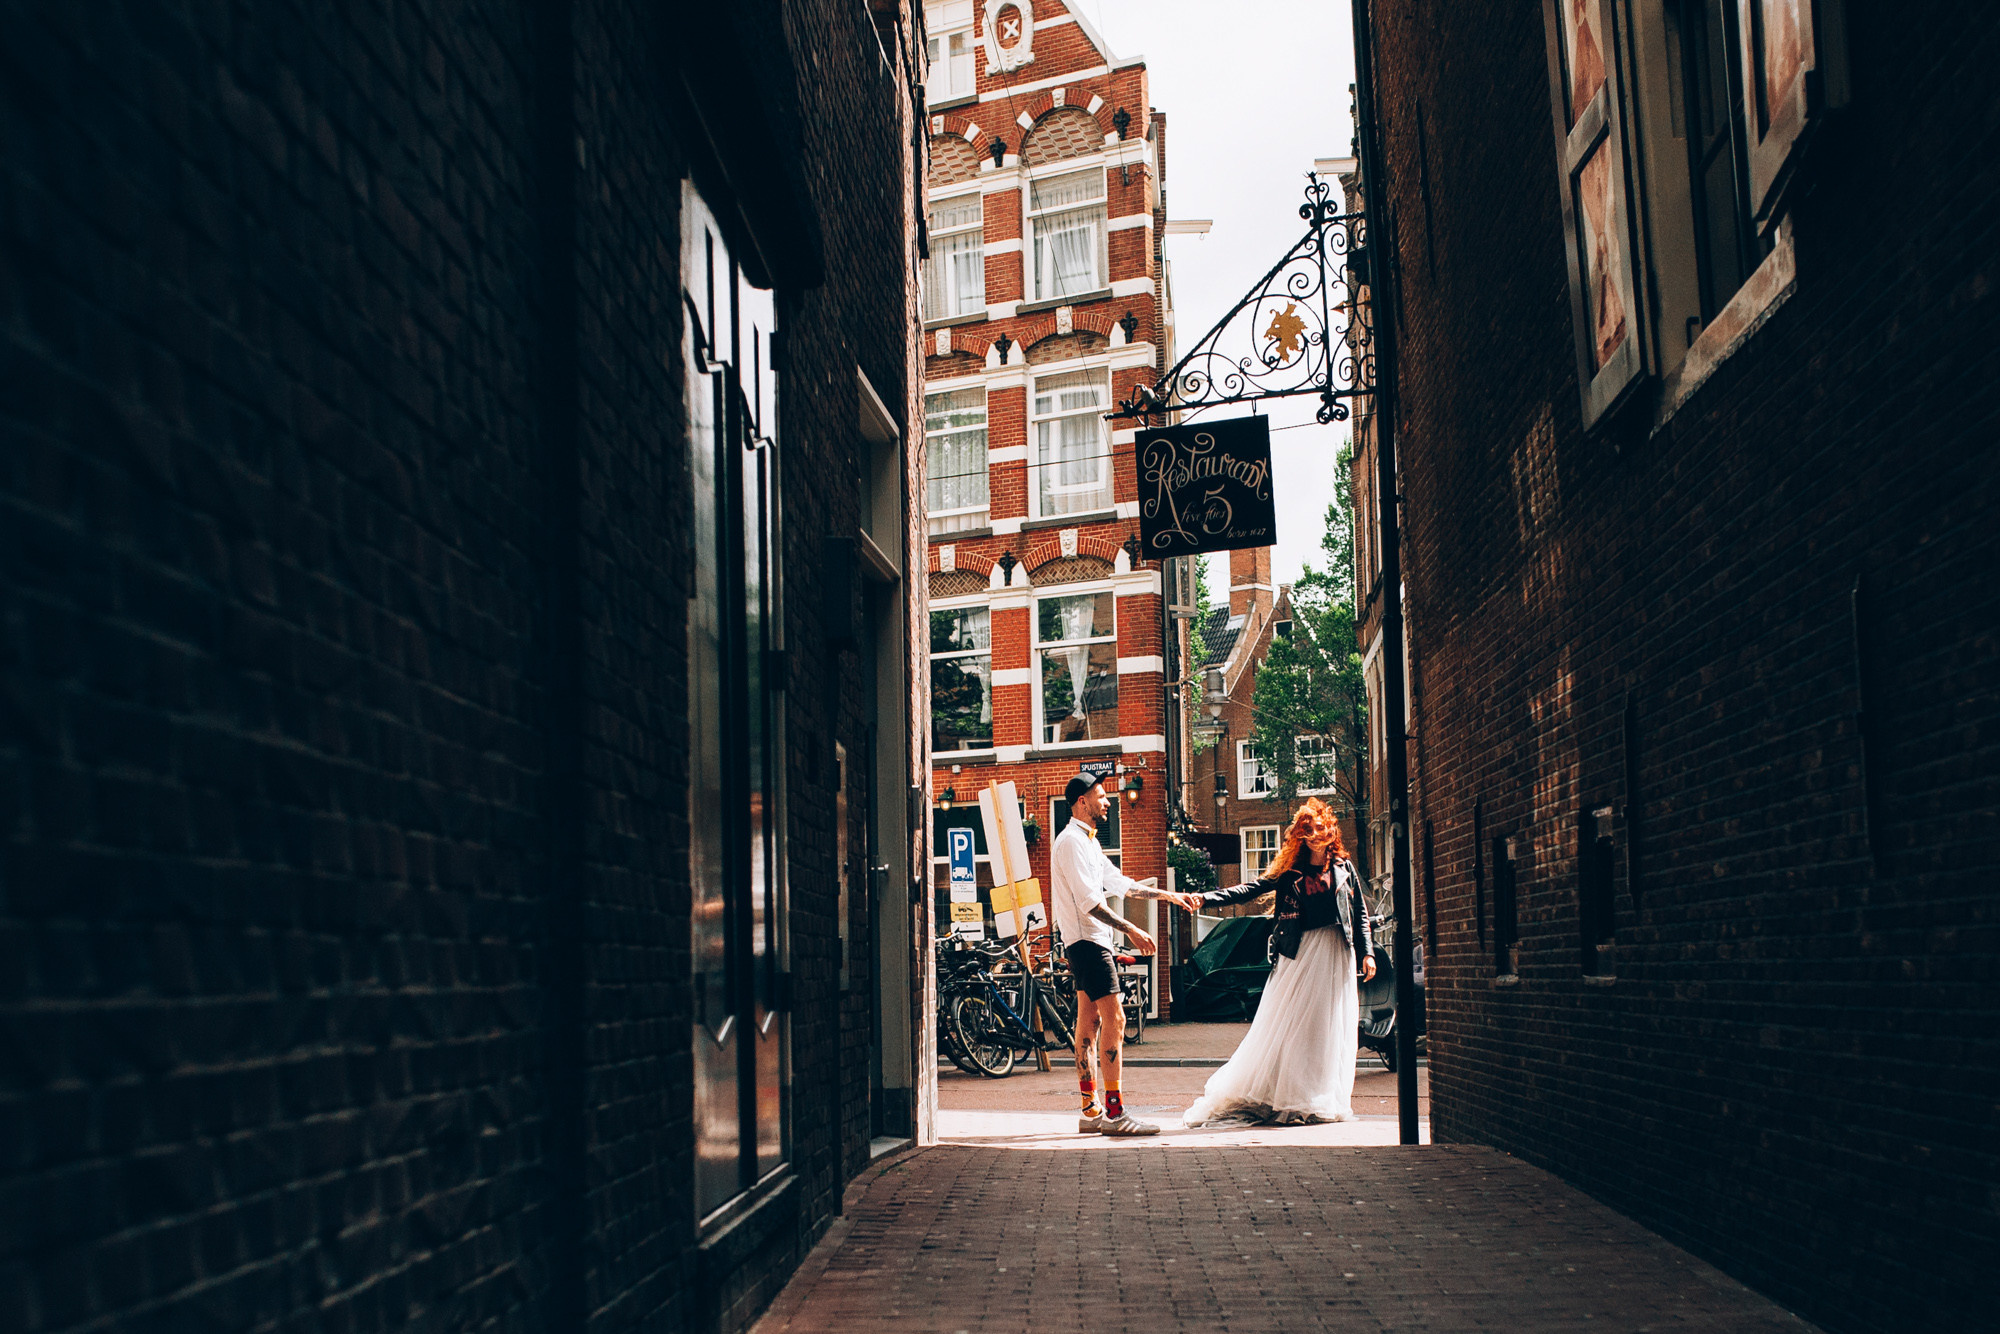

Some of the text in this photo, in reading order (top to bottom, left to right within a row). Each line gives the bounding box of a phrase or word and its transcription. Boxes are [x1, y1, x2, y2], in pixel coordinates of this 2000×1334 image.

[1143, 432, 1269, 549] Restaurant
[1203, 484, 1232, 535] 5
[1081, 762, 1113, 772] SPUISTRAAT
[953, 833, 969, 861] P
